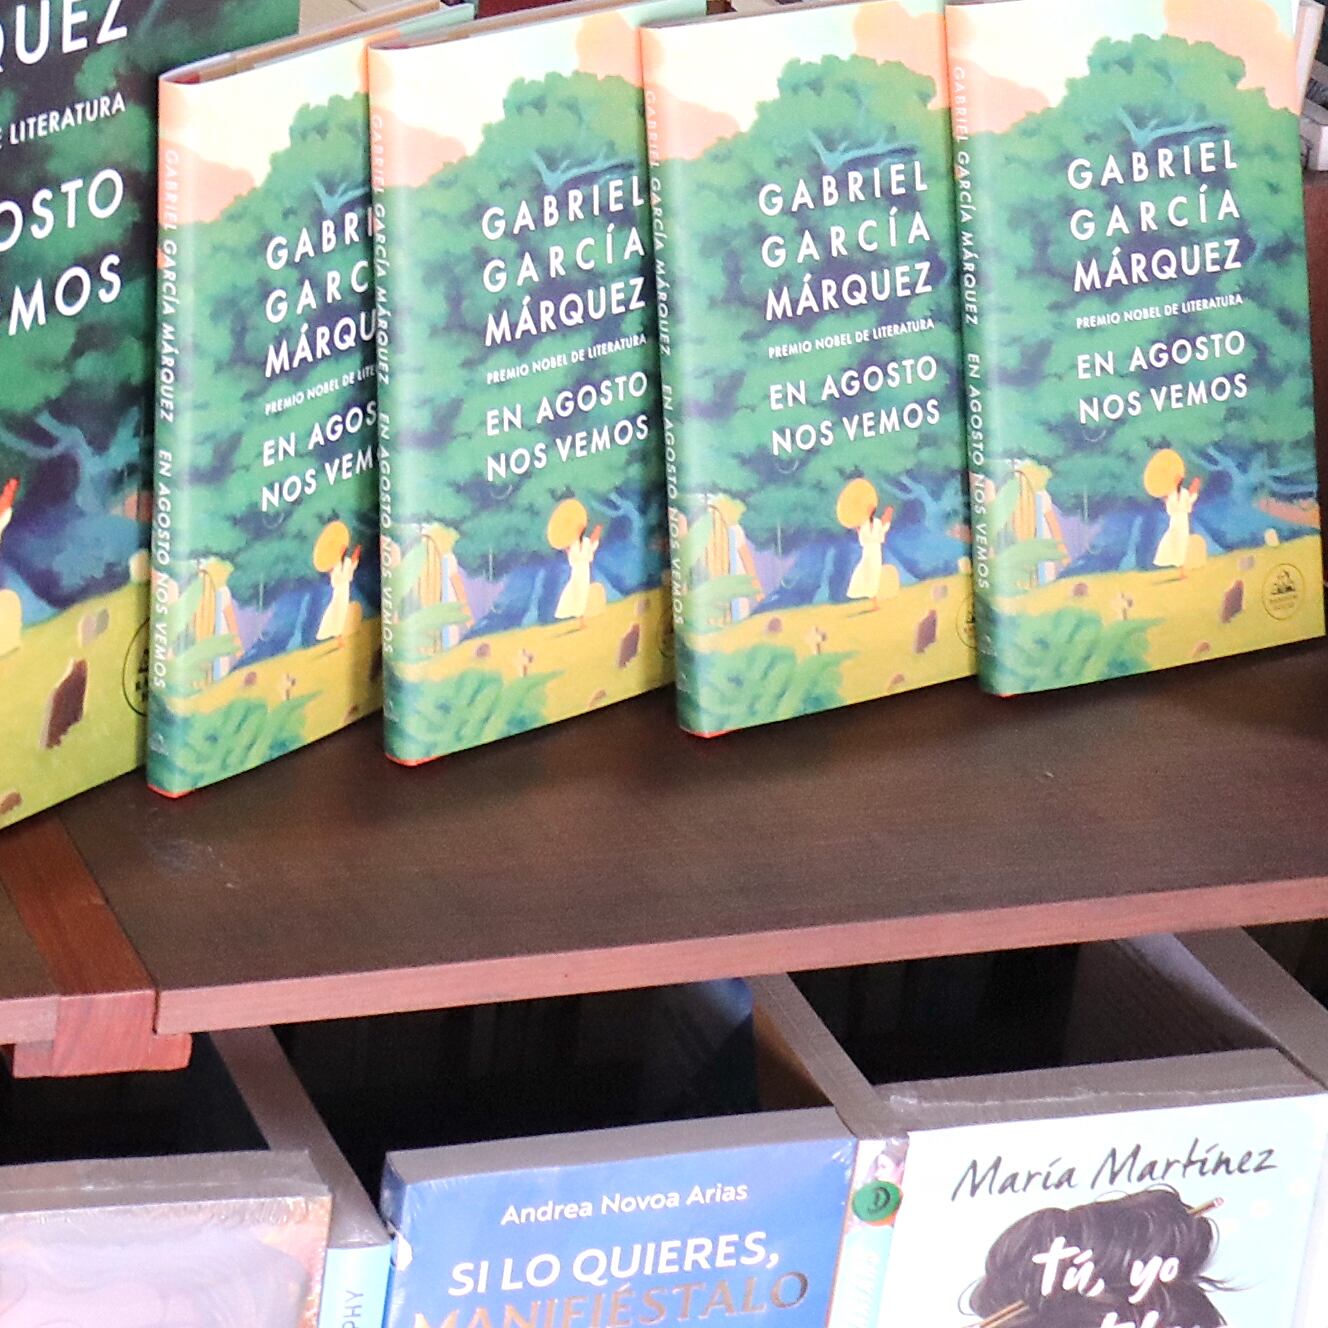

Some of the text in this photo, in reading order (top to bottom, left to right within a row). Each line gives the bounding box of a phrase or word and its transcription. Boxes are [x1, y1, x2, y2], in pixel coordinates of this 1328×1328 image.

[10, 94, 126, 145] LITERATURA
[759, 161, 928, 216] GABRIEL
[1068, 140, 1237, 190] GABRIEL
[482, 176, 645, 240] GABRIEL
[1070, 184, 1240, 240] GARCÍA
[483, 223, 645, 293] GARCÍA
[761, 207, 930, 268] GARCÍA
[1073, 238, 1242, 292] MÁRQUEZ
[485, 277, 645, 346] MÁRQUEZ
[765, 262, 932, 320] MÁRQUEZ
[1077, 294, 1243, 329] PREMIO NOBEL DE LITERATURA
[487, 334, 647, 384] PREMIO NOBEL DE LITERATURA
[768, 318, 934, 359] PREMIO NOBEL DE LITERATURA
[1077, 331, 1244, 379] EN AGOSTO
[486, 371, 648, 436] EN AGOSTO
[769, 355, 936, 410] EN AGOSTO
[1079, 374, 1247, 424] NOS VEMOS
[263, 400, 376, 468] EN AGOS
[486, 415, 648, 482] NOS VEMOS
[772, 399, 940, 455] NOS VEMOS
[261, 445, 374, 512] NOS VEM
[951, 1137, 1280, 1202] María Martínez
[501, 1182, 748, 1226] Andrea Novoa Arias
[448, 1231, 780, 1296] SI LO QUIERES,
[1032, 1236, 1179, 1303] tú, yo
